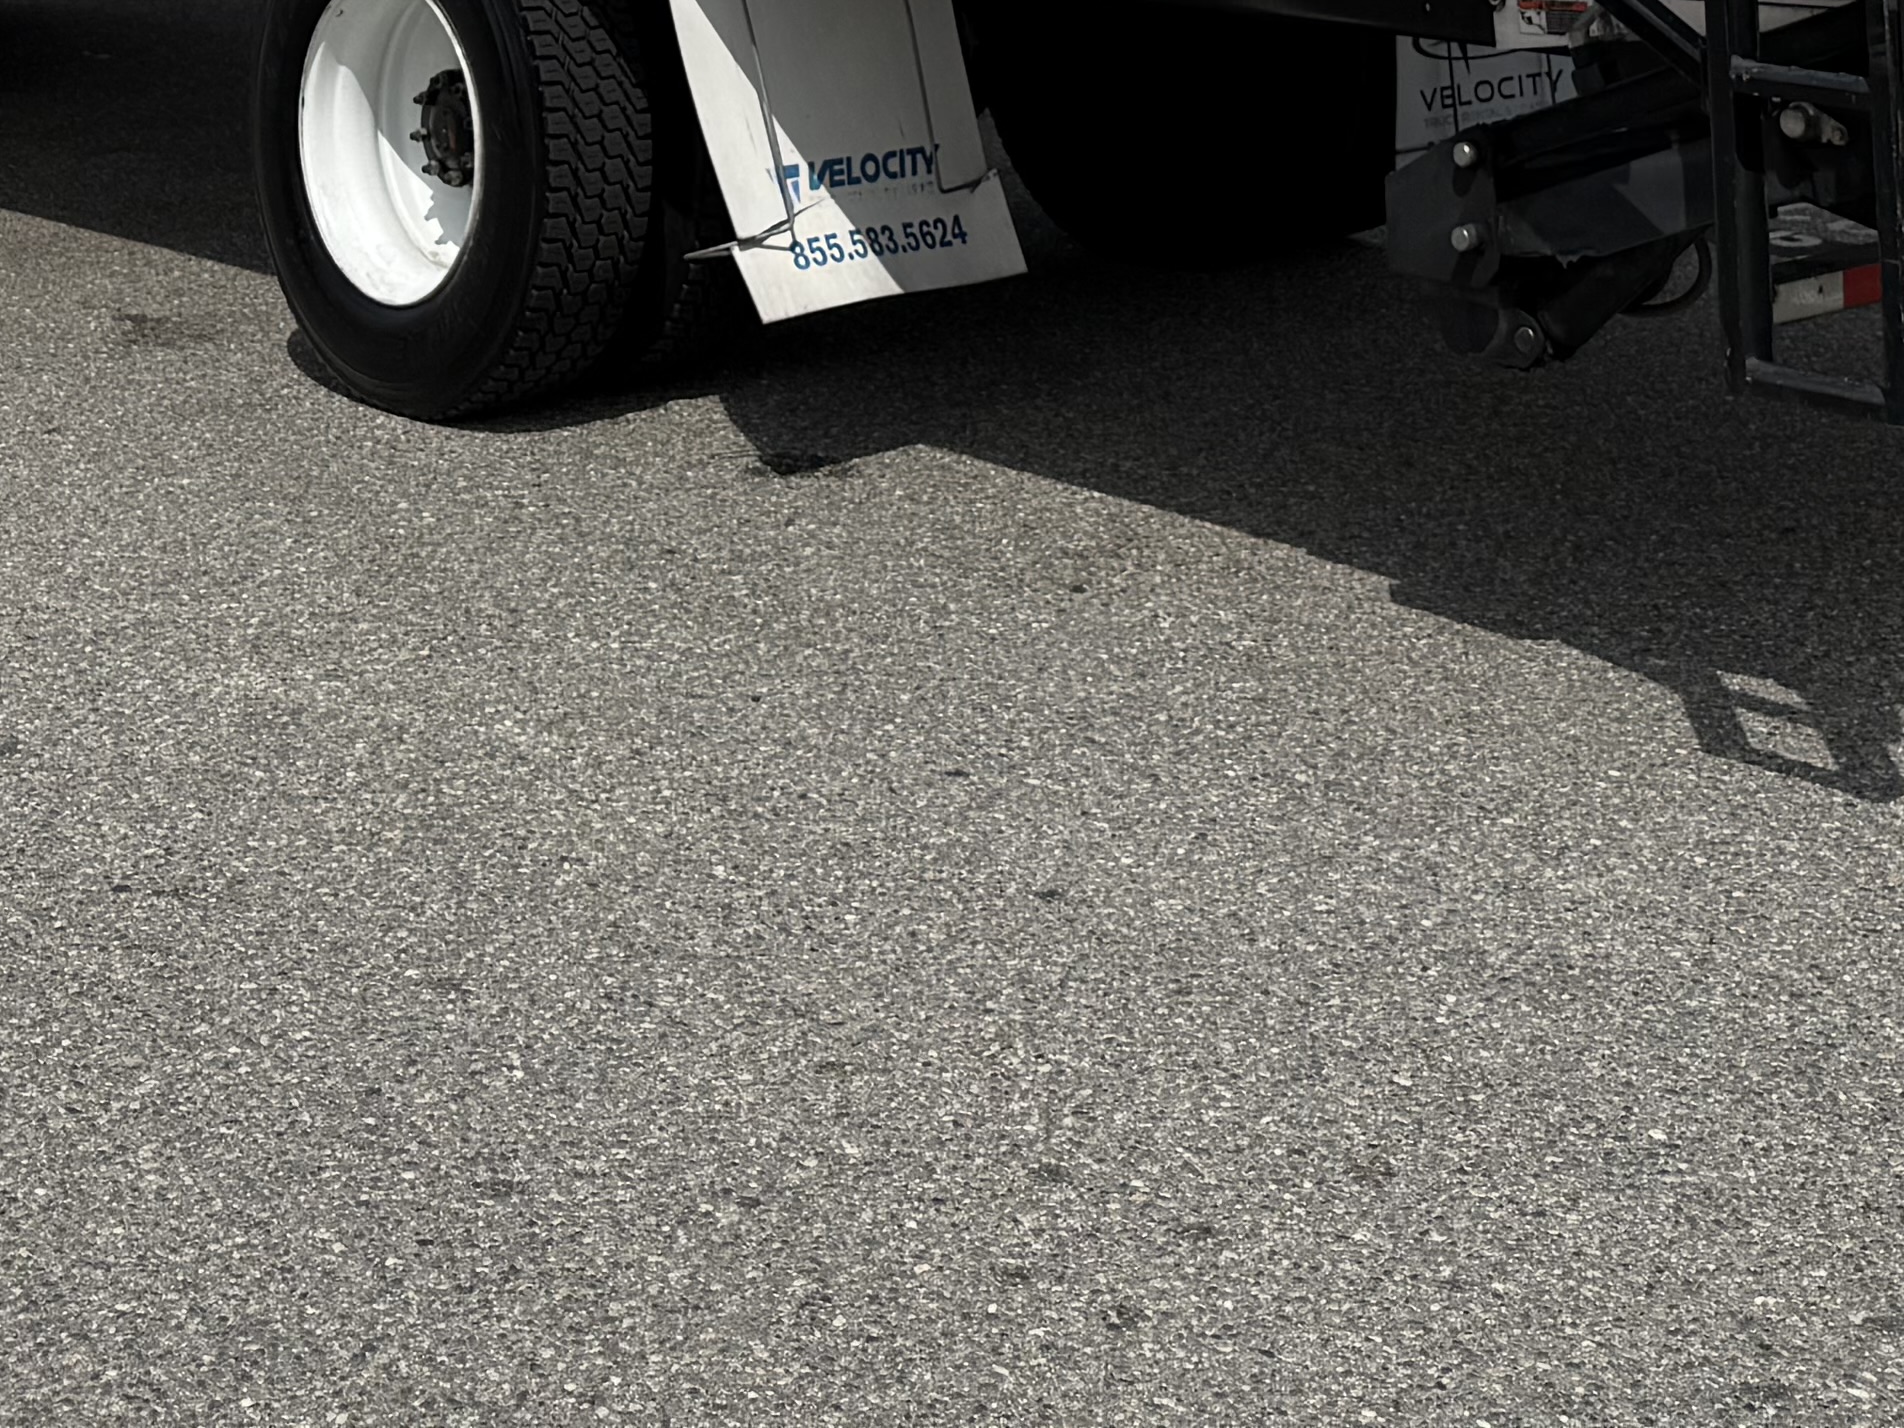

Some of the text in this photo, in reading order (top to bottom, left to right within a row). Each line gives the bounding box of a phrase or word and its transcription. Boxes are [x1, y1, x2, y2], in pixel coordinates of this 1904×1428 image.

[1420, 68, 1564, 112] VELOCITY
[808, 143, 940, 191] VELOCITY
[791, 214, 969, 271] 855.583.5624
